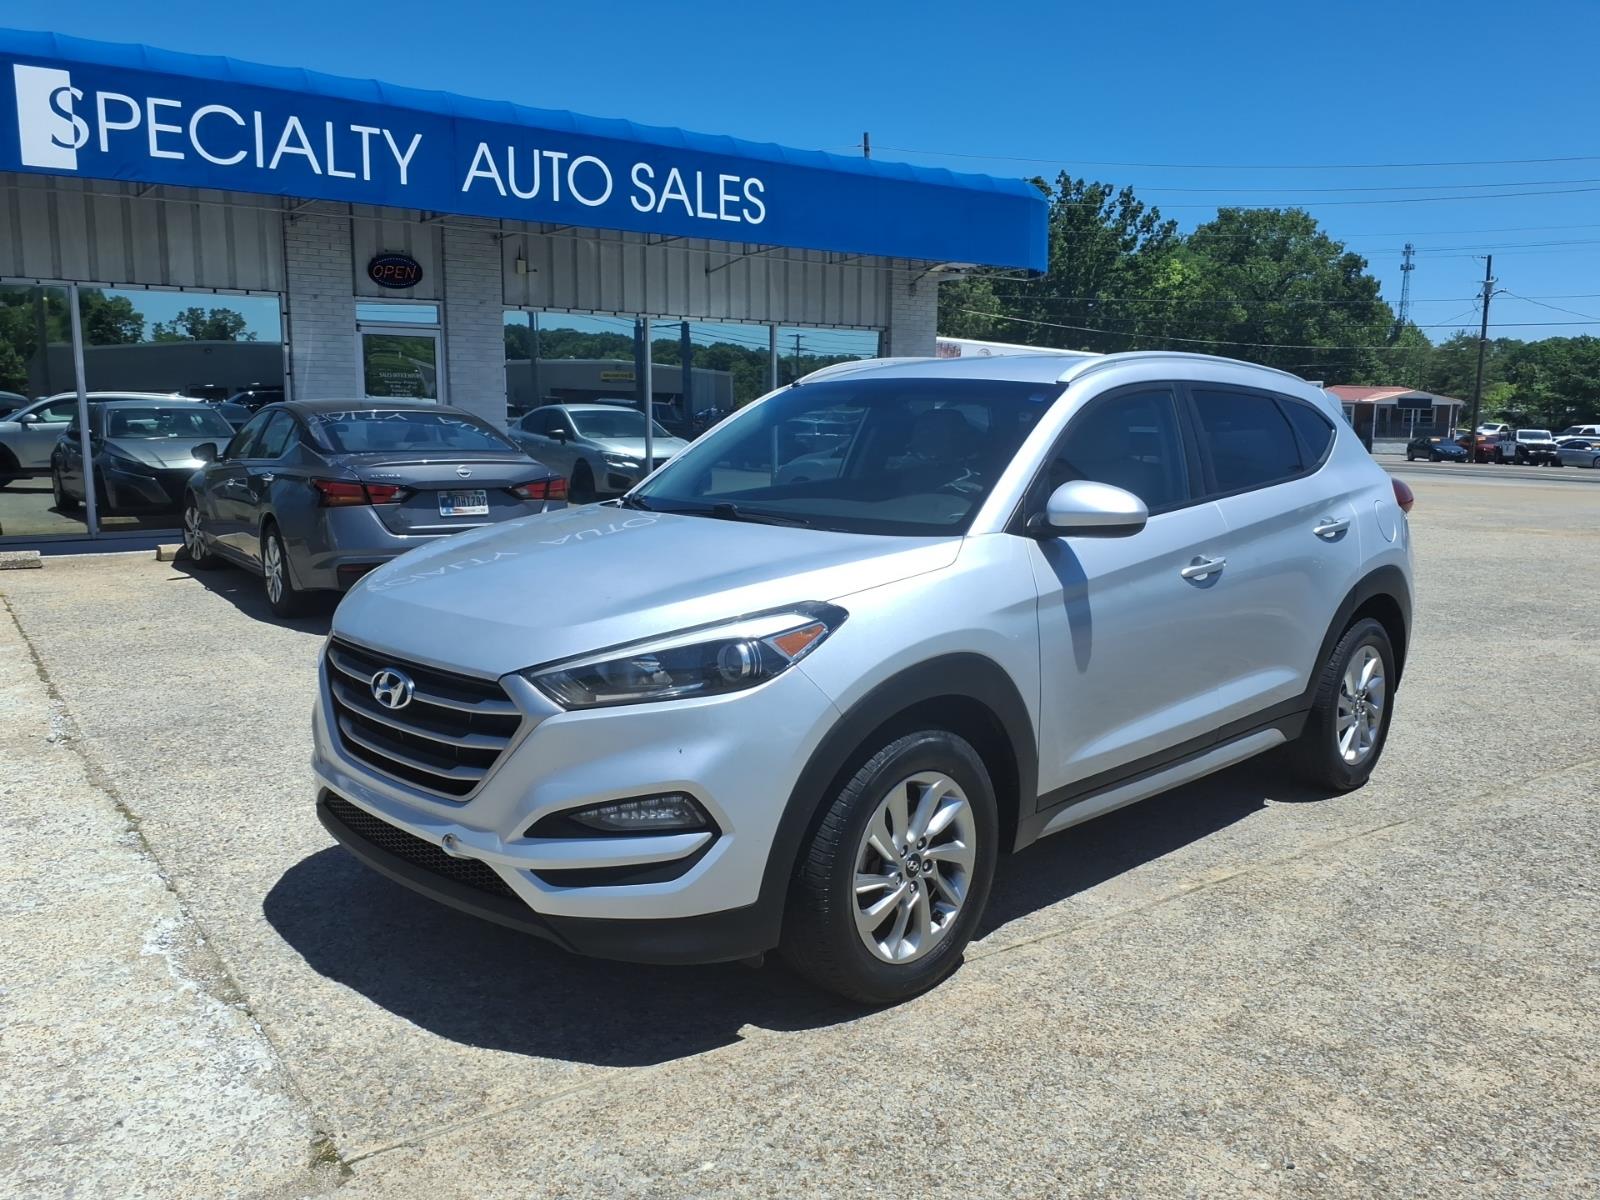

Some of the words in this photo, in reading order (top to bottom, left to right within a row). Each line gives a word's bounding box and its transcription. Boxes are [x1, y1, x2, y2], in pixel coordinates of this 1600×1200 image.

[48, 86, 423, 185] SPECIALTY
[461, 142, 613, 207] AUTO
[630, 162, 766, 225] SALES
[372, 264, 417, 279] OPEN
